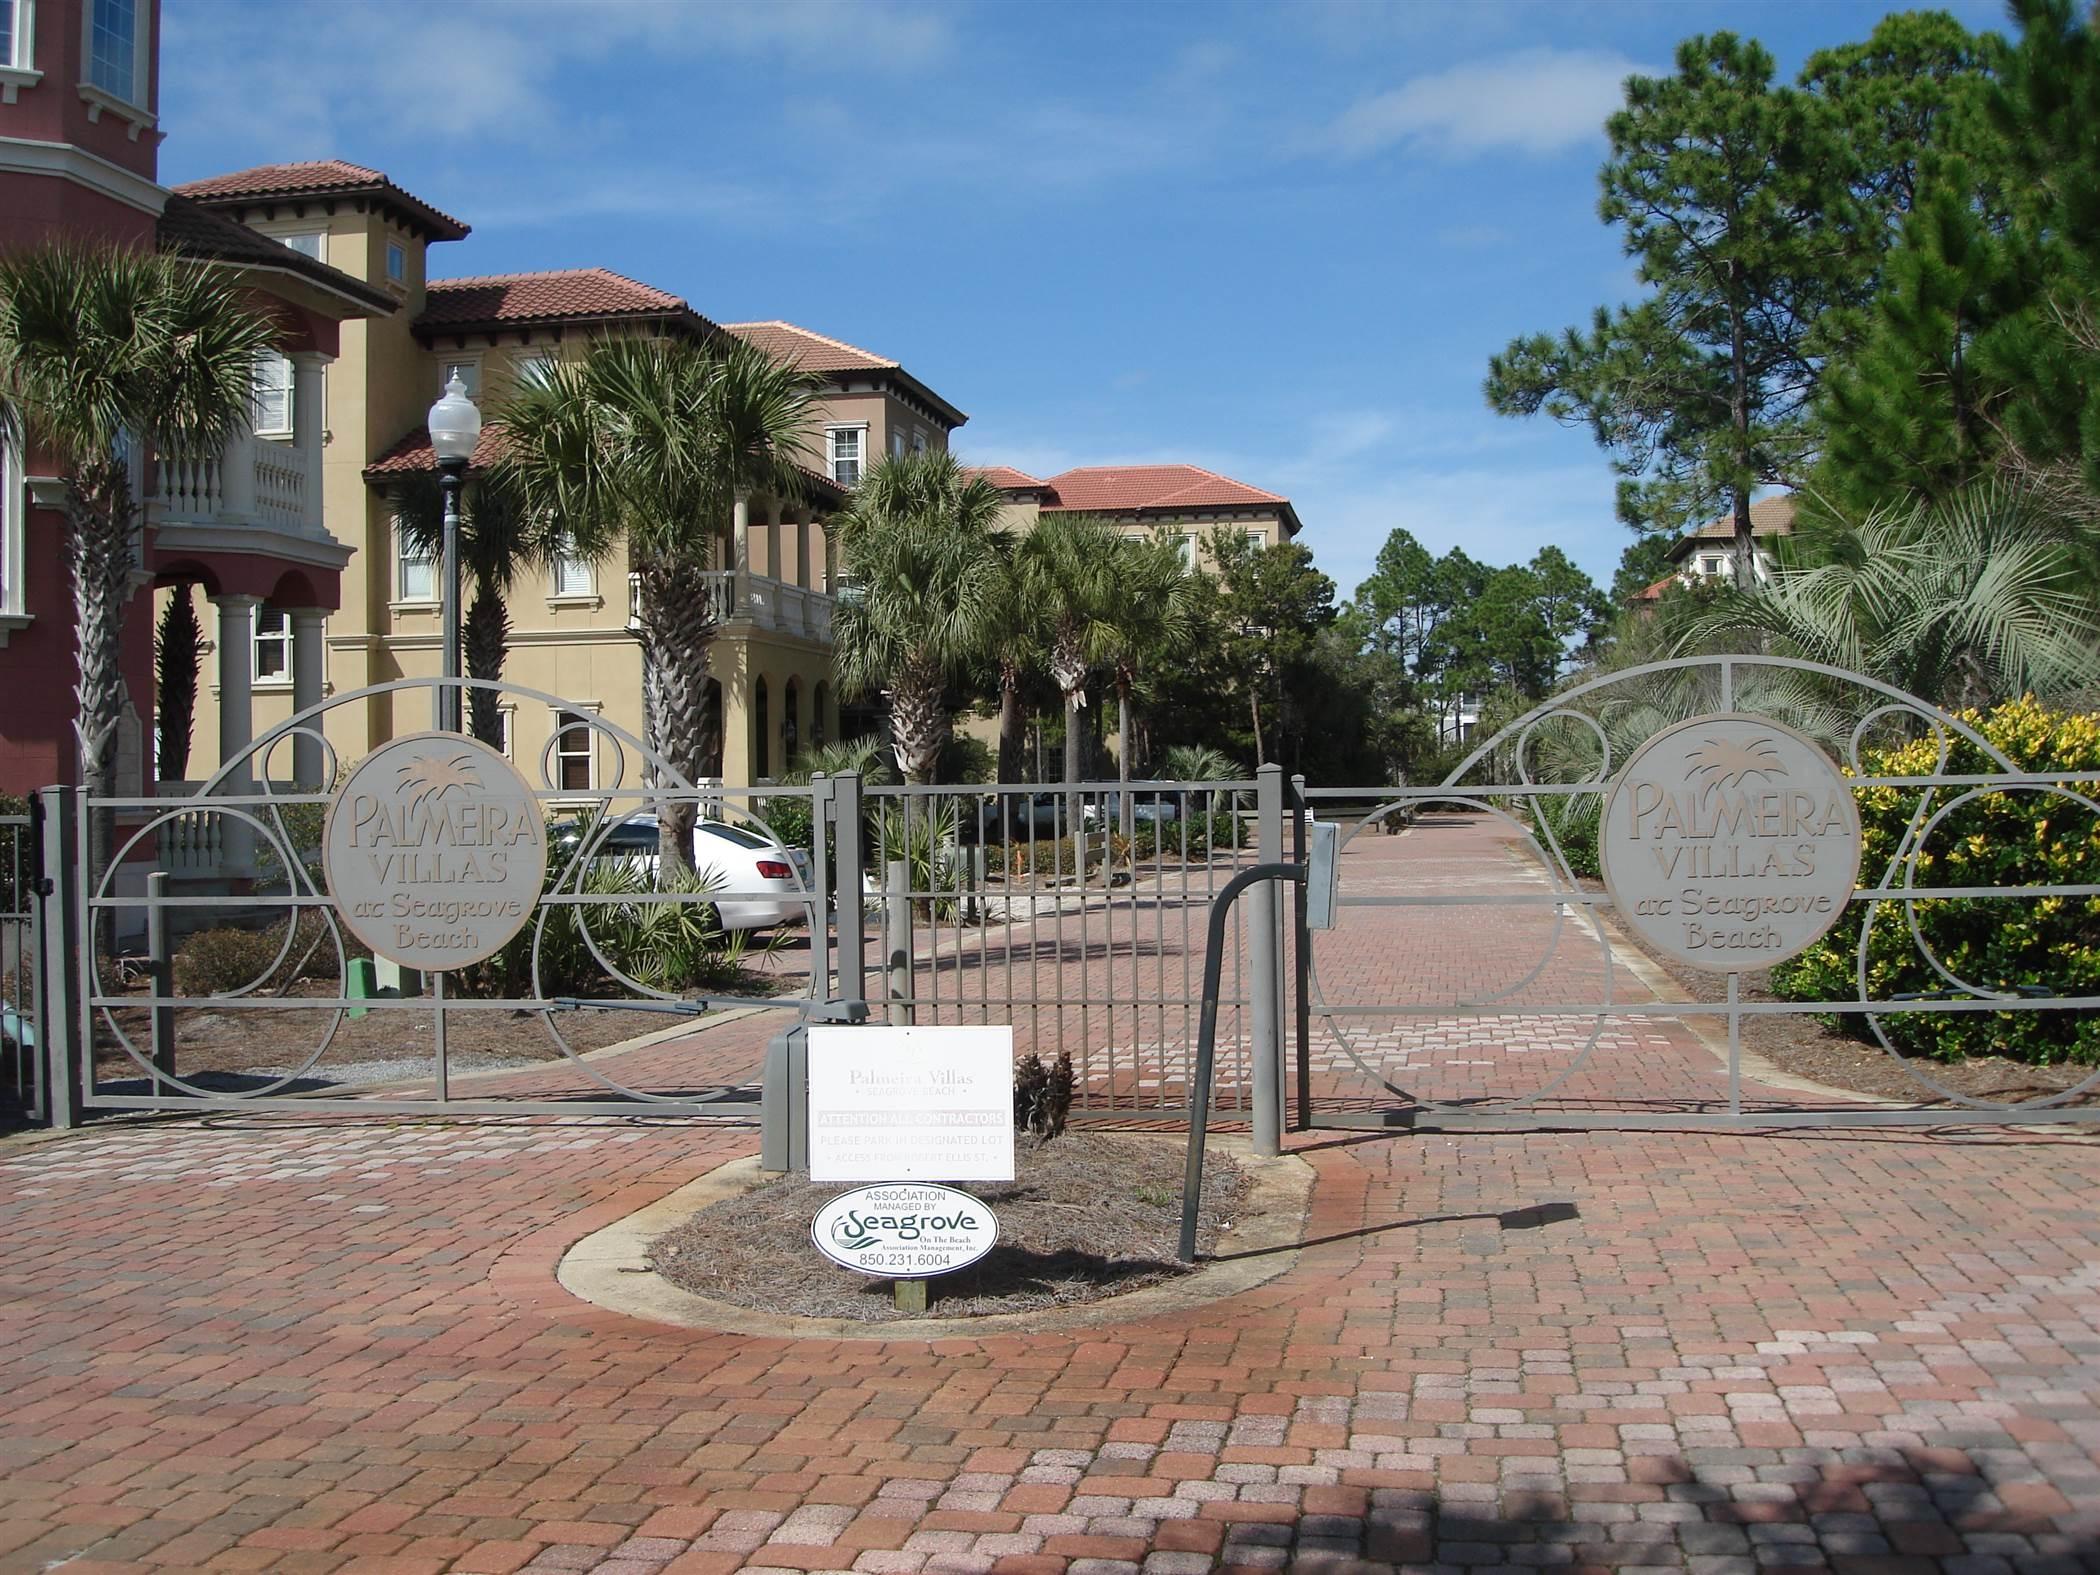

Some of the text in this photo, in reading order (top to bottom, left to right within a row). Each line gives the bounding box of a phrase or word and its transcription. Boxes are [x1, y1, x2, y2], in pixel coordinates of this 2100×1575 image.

[347, 794, 538, 848] PALMEIRA
[1624, 779, 1850, 840] PALMEIRA
[368, 851, 508, 885] VILLAS
[1651, 844, 1816, 880] VILLAS
[392, 893, 521, 924] Seagrove
[1680, 889, 1832, 921] Seagrove
[394, 923, 479, 949] Beach
[1683, 922, 1782, 950] Beach
[849, 1069, 973, 1085] Palmeira Villas
[922, 1086, 955, 1096] BEACH
[820, 1113, 886, 1125] ATTENTION
[915, 1112, 1004, 1125] CONTRACTORS
[820, 1135, 861, 1145] PLEASE
[864, 1135, 893, 1145] PARK
[911, 1135, 978, 1145] DESIGNATED
[981, 1135, 1004, 1145] LOT
[835, 1153, 871, 1163] ACCESS
[946, 1153, 973, 1163] ELLIS
[866, 1191, 946, 1201] ASSOCIATION
[874, 1203, 937, 1211] MANAGED BY
[844, 1210, 979, 1240] Seagrove
[860, 1254, 950, 1266] 850.231.6004
